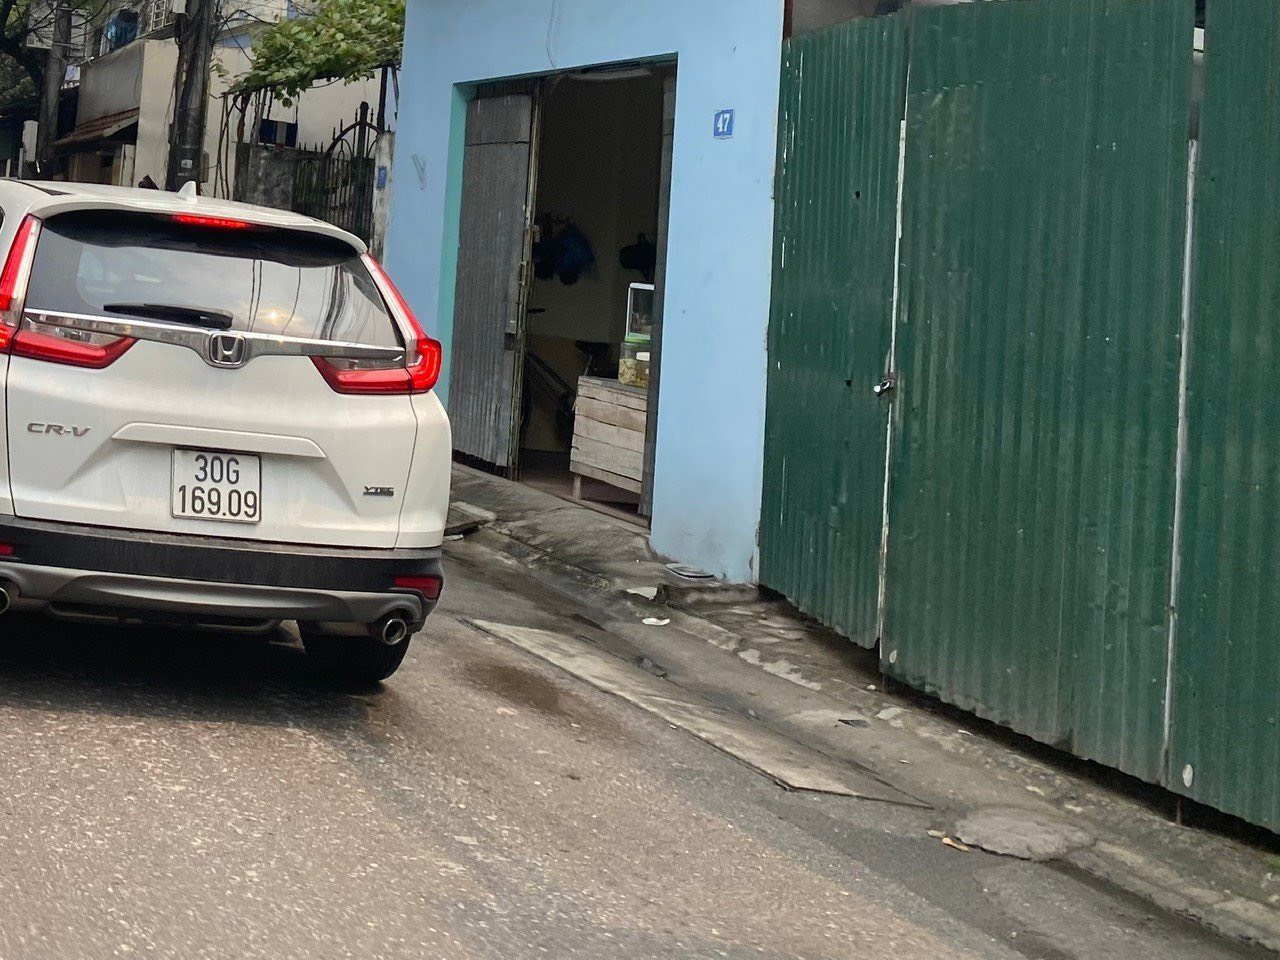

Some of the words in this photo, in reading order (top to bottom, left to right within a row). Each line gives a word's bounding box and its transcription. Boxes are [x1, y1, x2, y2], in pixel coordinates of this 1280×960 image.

[717, 113, 730, 132] 47
[27, 423, 91, 437] CR-V
[194, 454, 240, 485] 30G
[178, 485, 257, 518] 169.09
